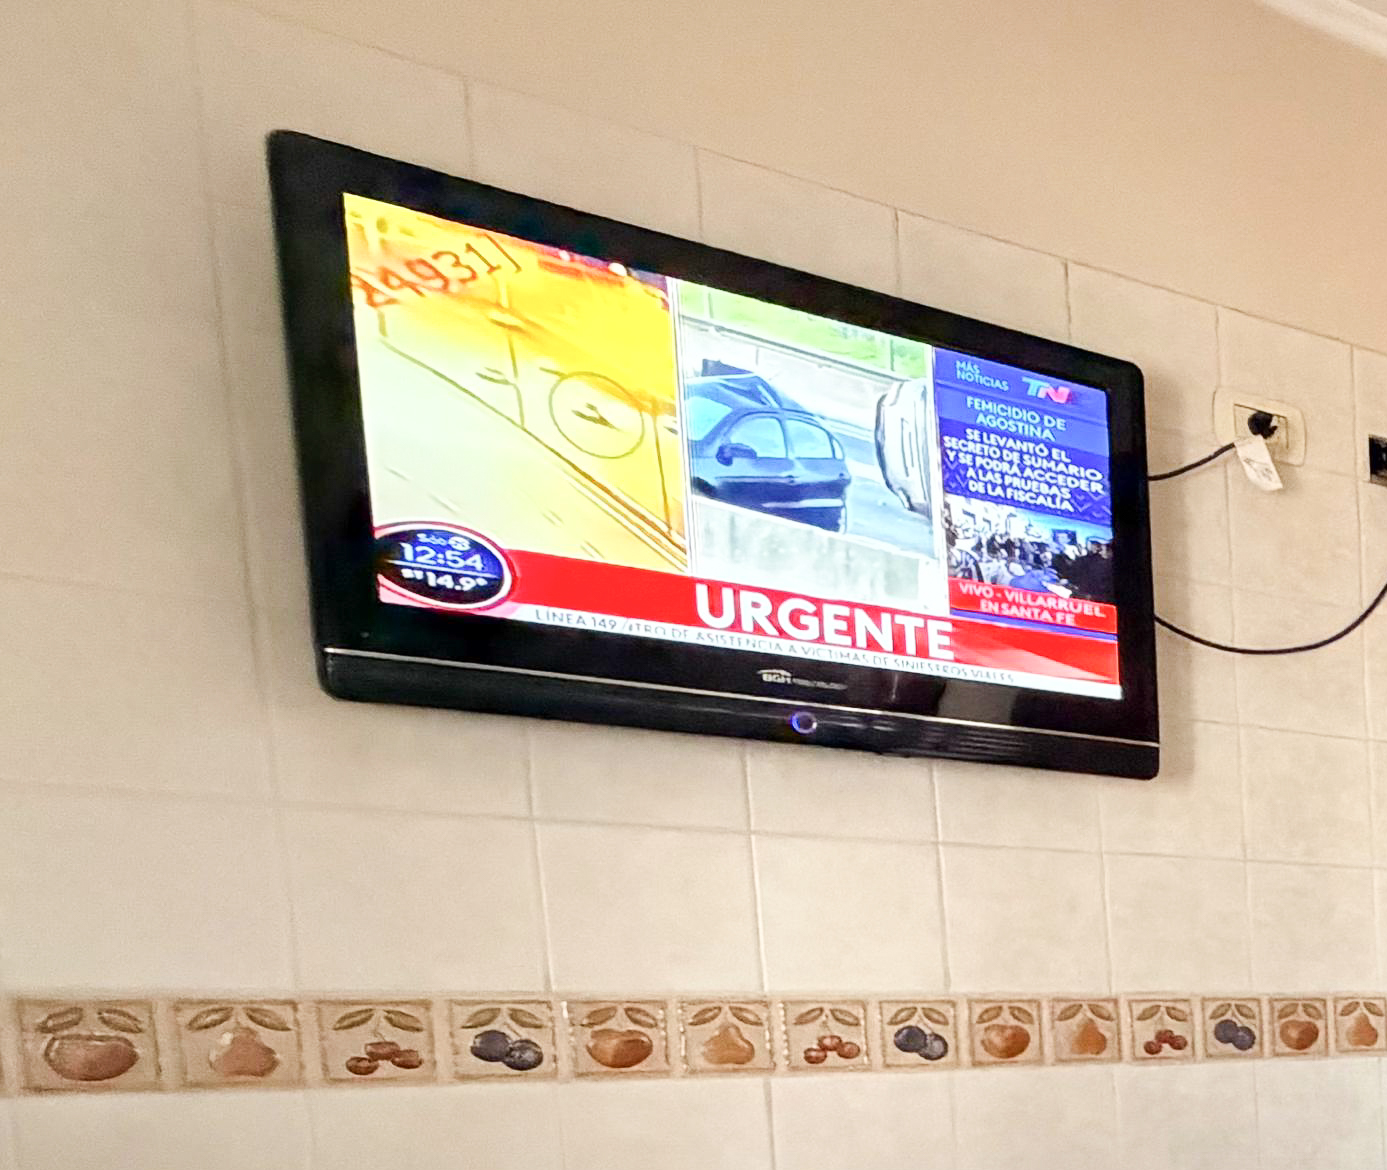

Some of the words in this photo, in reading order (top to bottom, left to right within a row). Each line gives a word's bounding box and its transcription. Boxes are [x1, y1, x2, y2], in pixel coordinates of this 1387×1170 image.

[956, 369, 1009, 391] NOTICIAS
[967, 395, 1040, 424] FEMICIDIO
[1043, 415, 1066, 431] DE
[976, 412, 1056, 442] AGOSTINA
[943, 435, 1001, 459] SECRETO
[1002, 447, 1020, 463] DE
[1023, 453, 1103, 481] SUMARIO
[966, 428, 980, 441] SE
[983, 432, 1048, 457] LEVANTÓ
[1051, 447, 1071, 463] EL
[946, 450, 957, 462] Y
[959, 453, 973, 466] SE
[975, 455, 1021, 477] PODRÁ
[1023, 466, 1105, 494] ACCEDER
[966, 467, 977, 478] A
[978, 470, 1003, 485] LAS
[1004, 475, 1071, 499] PRUEBAS
[968, 481, 986, 494] DE
[987, 485, 1005, 498] LA
[1006, 487, 1075, 513] FISCALÍA
[399, 542, 484, 572] 12:54
[958, 582, 994, 598] VIVO
[1004, 590, 1107, 618] VILLARRUEL
[979, 600, 999, 613] EN
[1000, 602, 1054, 623] SANTA
[1056, 610, 1076, 626] FE
[534, 606, 588, 627] LÍNEA
[591, 615, 618, 631] 149
[695, 582, 956, 661] URGENTE
